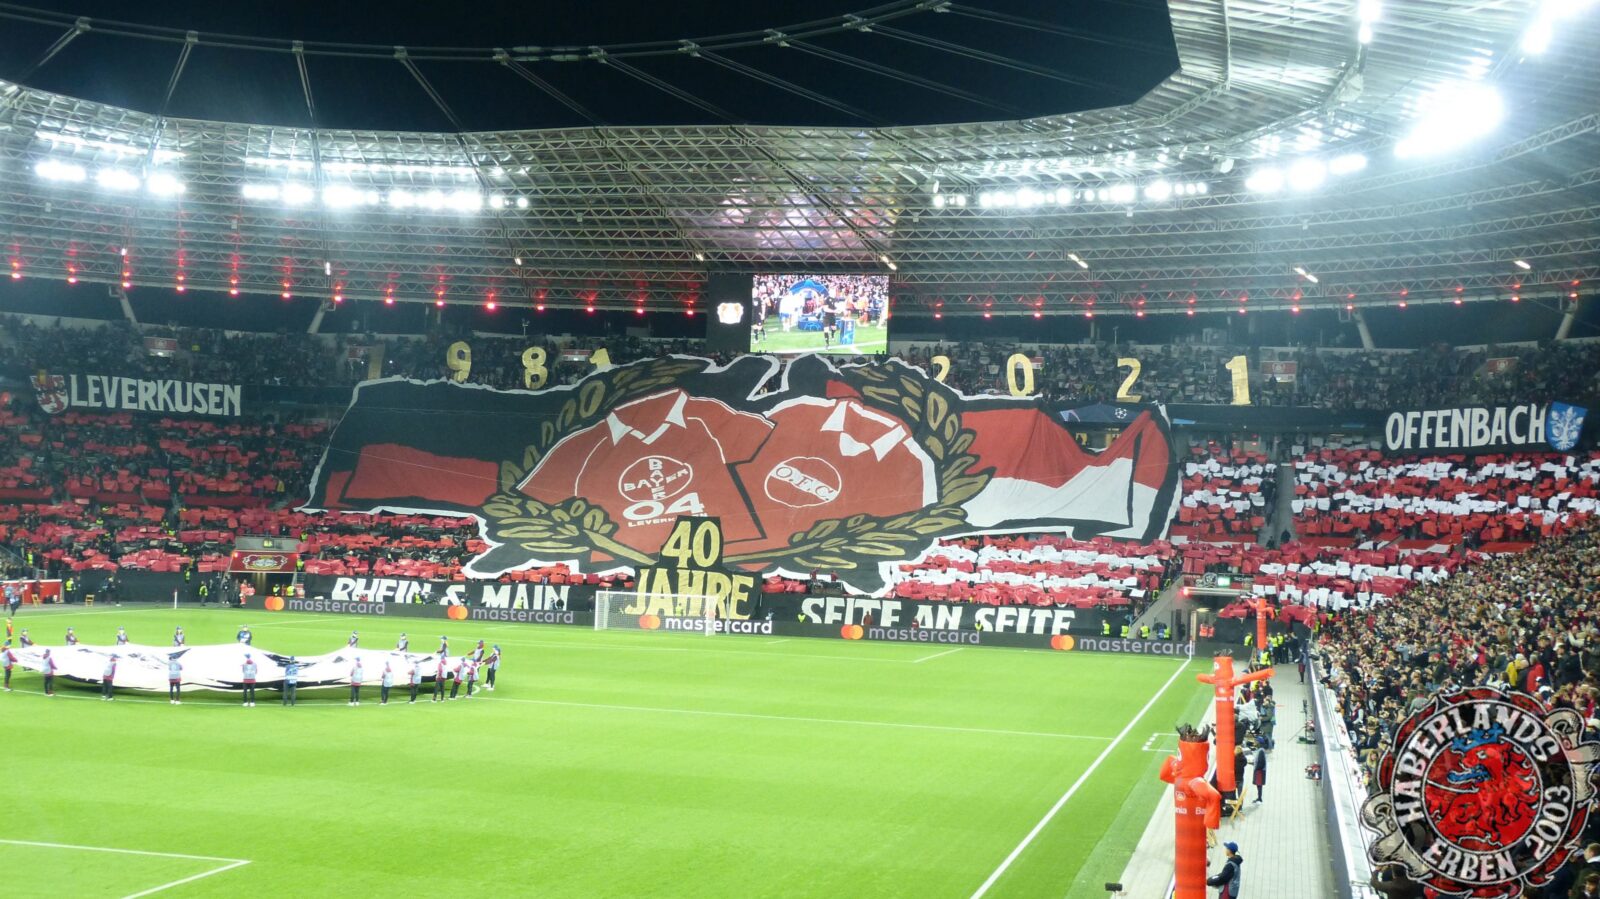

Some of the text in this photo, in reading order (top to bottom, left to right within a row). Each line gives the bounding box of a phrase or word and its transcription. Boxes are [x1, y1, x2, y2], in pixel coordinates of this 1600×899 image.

[69, 374, 242, 417] LEVERKUSEN
[1385, 403, 1548, 451] OFFENBACH
[622, 492, 705, 521] 04
[661, 520, 720, 567] 40
[482, 584, 570, 610] MAIN
[625, 567, 754, 620] JAHRE
[289, 598, 386, 616] mastercard
[473, 607, 574, 625] mastercard
[914, 604, 964, 630] AN
[665, 616, 773, 635] mastercard
[869, 625, 980, 644] mastercard
[1080, 636, 1196, 656] mastercard
